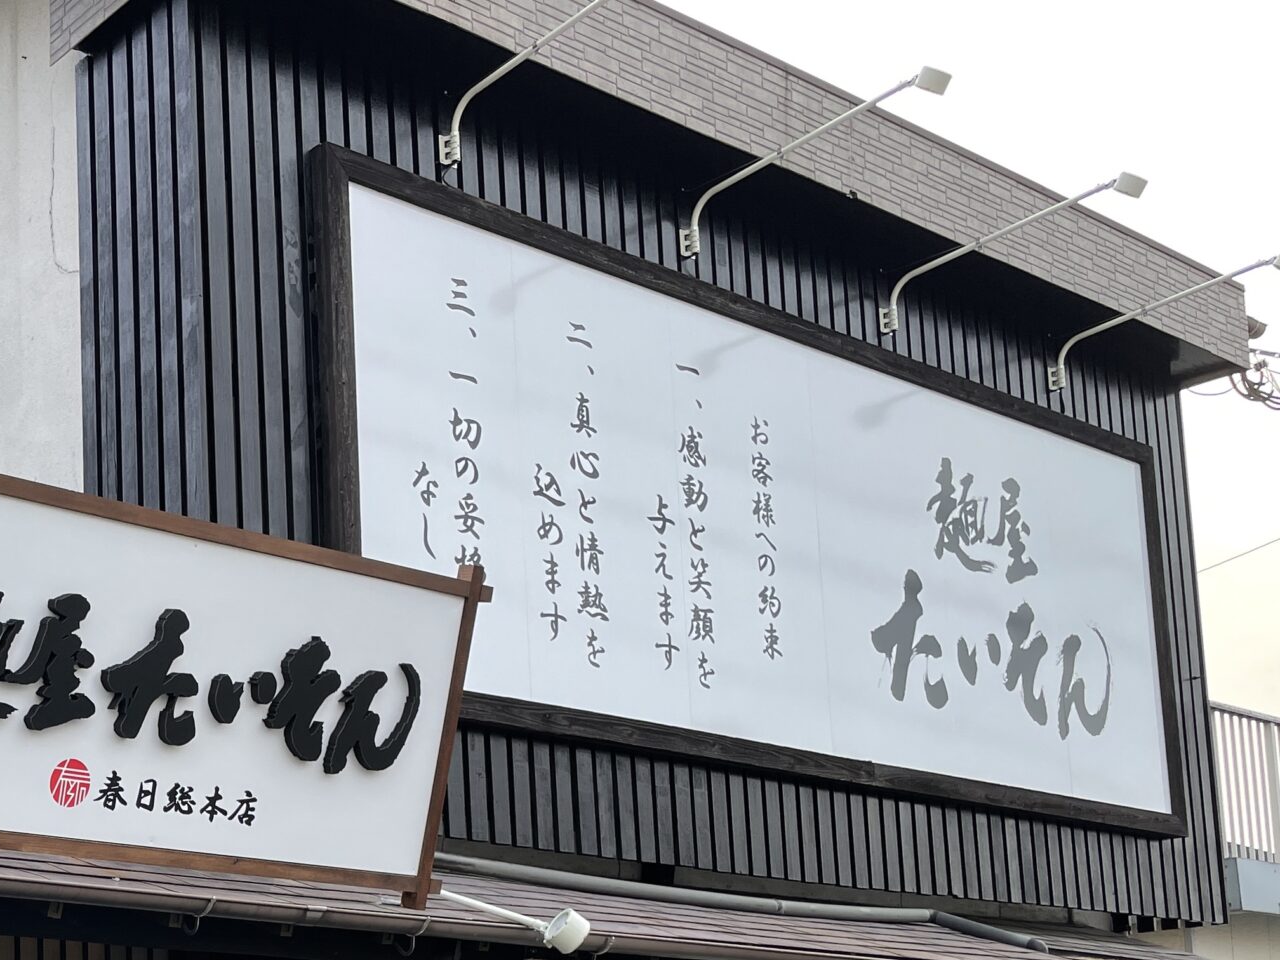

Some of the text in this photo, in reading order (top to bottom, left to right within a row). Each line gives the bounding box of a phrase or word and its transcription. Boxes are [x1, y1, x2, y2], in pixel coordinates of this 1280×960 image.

[412, 461, 439, 560] なし
[532, 463, 568, 641] 込めます
[566, 321, 609, 668] 二、真心と情熱を
[646, 494, 681, 671] 与えます
[675, 363, 715, 689] 一、感動と笑顔を
[750, 416, 783, 660] お客様への約束
[926, 457, 1039, 584] 麺屋
[870, 568, 1111, 741] たいそん
[93, 770, 258, 827] 春日総本店
